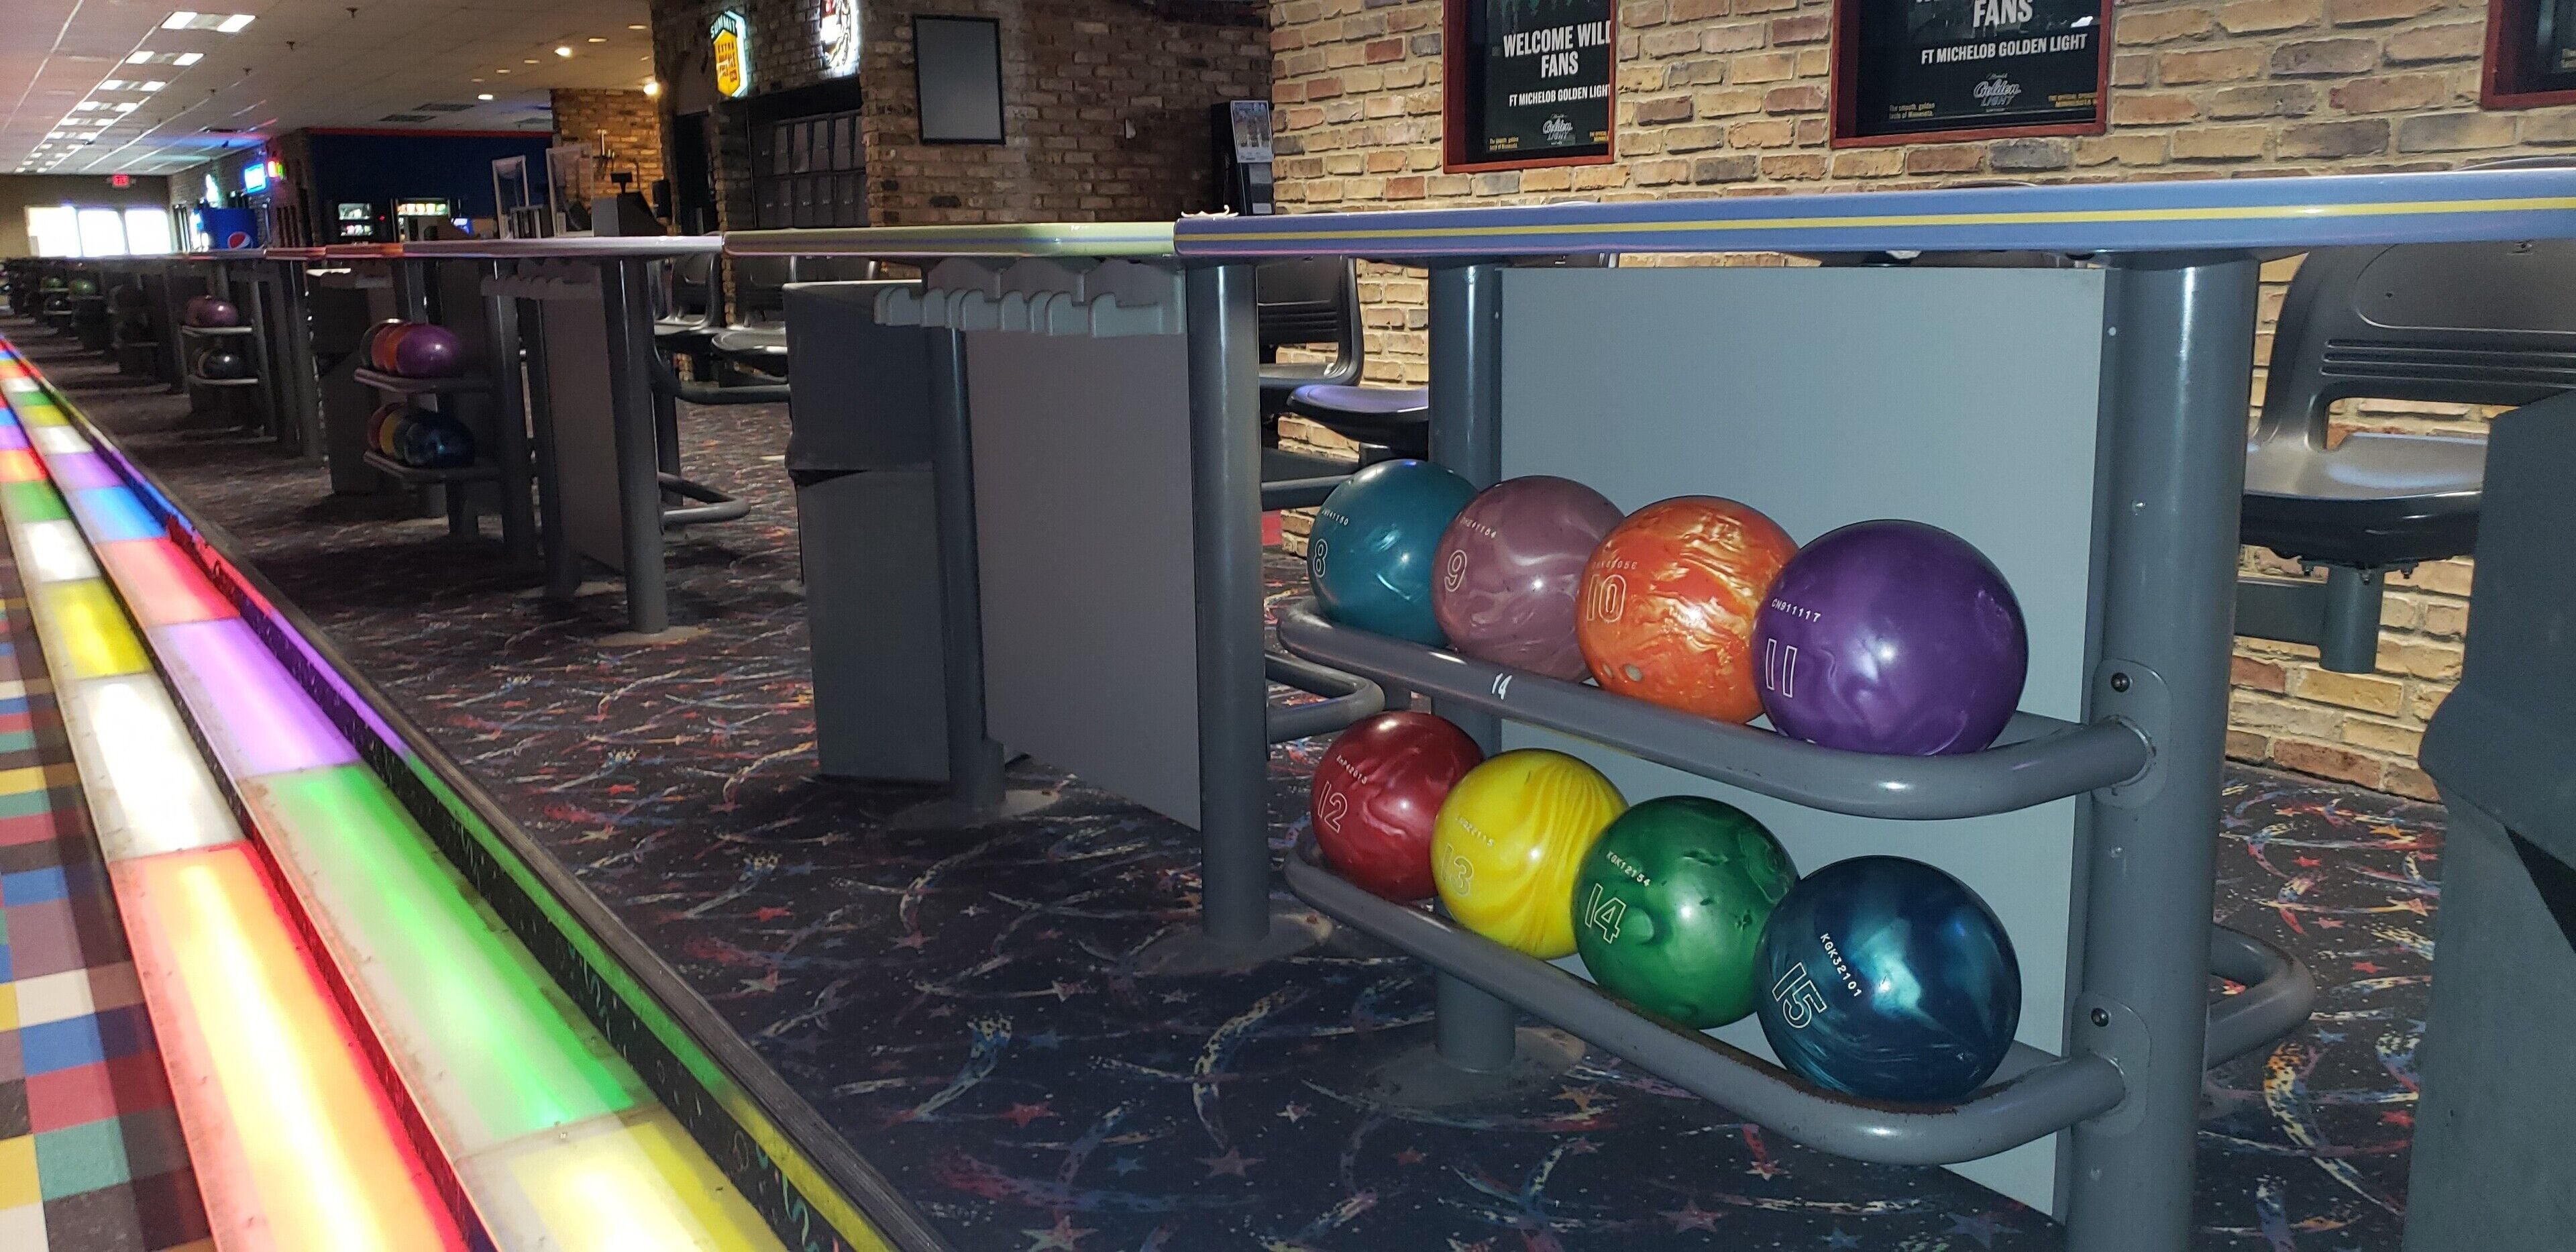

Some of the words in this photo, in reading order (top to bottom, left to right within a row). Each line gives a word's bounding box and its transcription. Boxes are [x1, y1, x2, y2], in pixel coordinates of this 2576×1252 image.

[710, 14, 737, 40] SUMMIT
[1973, 0, 2033, 28] FANS
[1503, 25, 1574, 58] WELCOME
[1921, 50, 1934, 64] FT
[1936, 43, 1996, 62] MICHELOB
[1998, 38, 2047, 56] GOLDEN
[2049, 34, 2088, 52] LIGHT
[1541, 50, 1579, 79] FANS
[1509, 94, 1518, 107] FT
[1519, 90, 1556, 106] MICHELOB
[1558, 86, 1588, 101] GOLDEN
[1313, 538, 1328, 578] 8
[1444, 550, 1467, 592] 9
[1587, 574, 1627, 623] 10
[1491, 672, 1513, 700] 14
[1765, 638, 1797, 698] 11
[1318, 780, 1348, 834] 12
[1442, 843, 1474, 897] 13
[1585, 882, 1627, 944] 14
[1820, 933, 1862, 997] KGK32101
[1772, 961, 1827, 1029] 15
